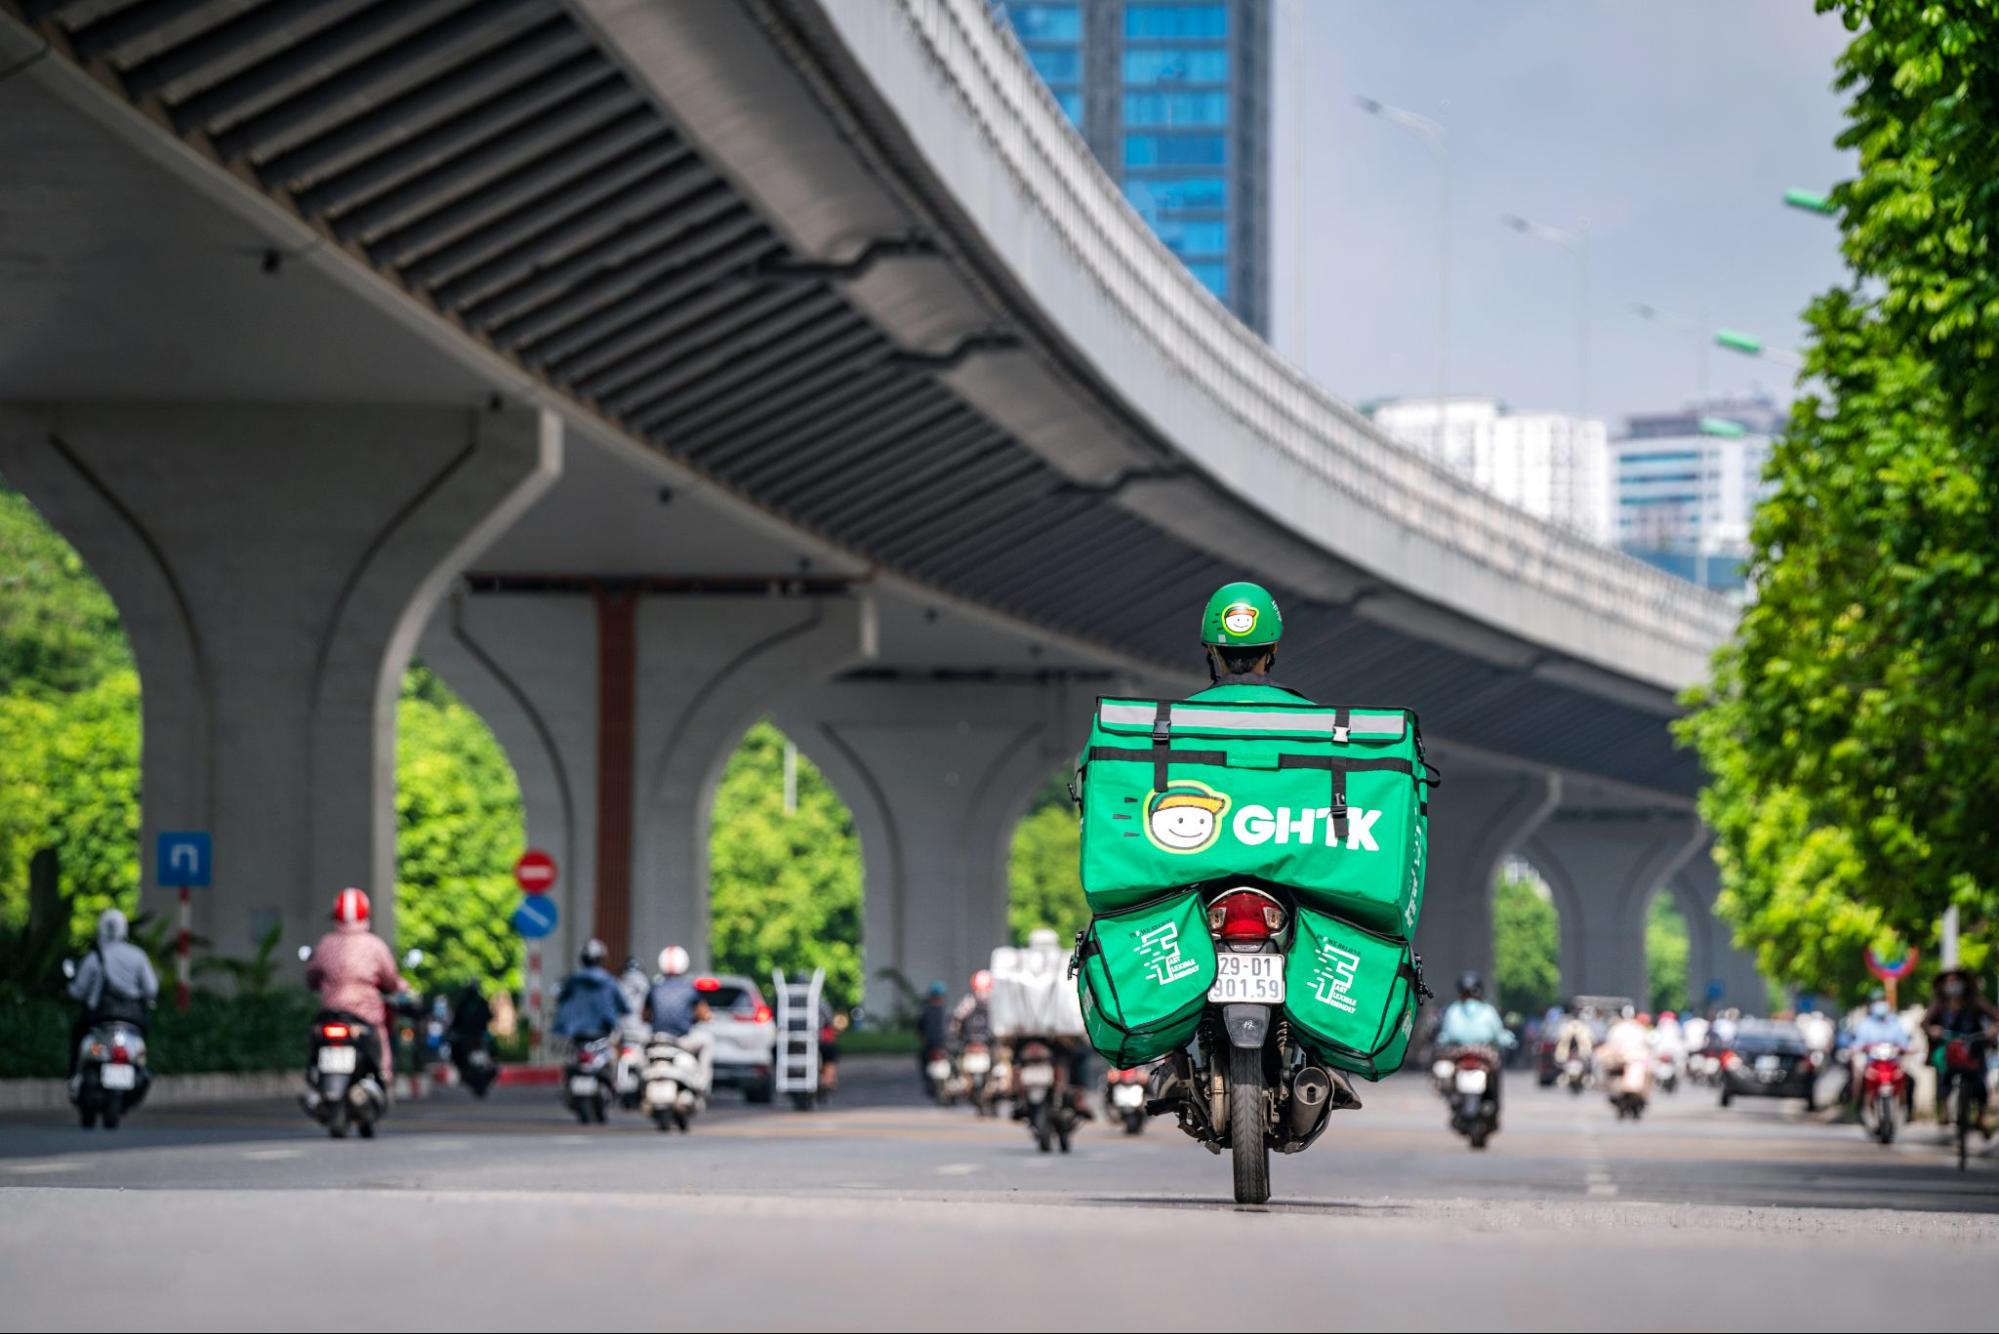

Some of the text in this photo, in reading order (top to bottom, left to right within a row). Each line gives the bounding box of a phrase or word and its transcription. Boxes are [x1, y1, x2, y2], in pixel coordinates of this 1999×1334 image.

[1233, 804, 1383, 852] GHTK
[1219, 956, 1271, 977] 29-D1
[1213, 978, 1279, 998] 901.59
